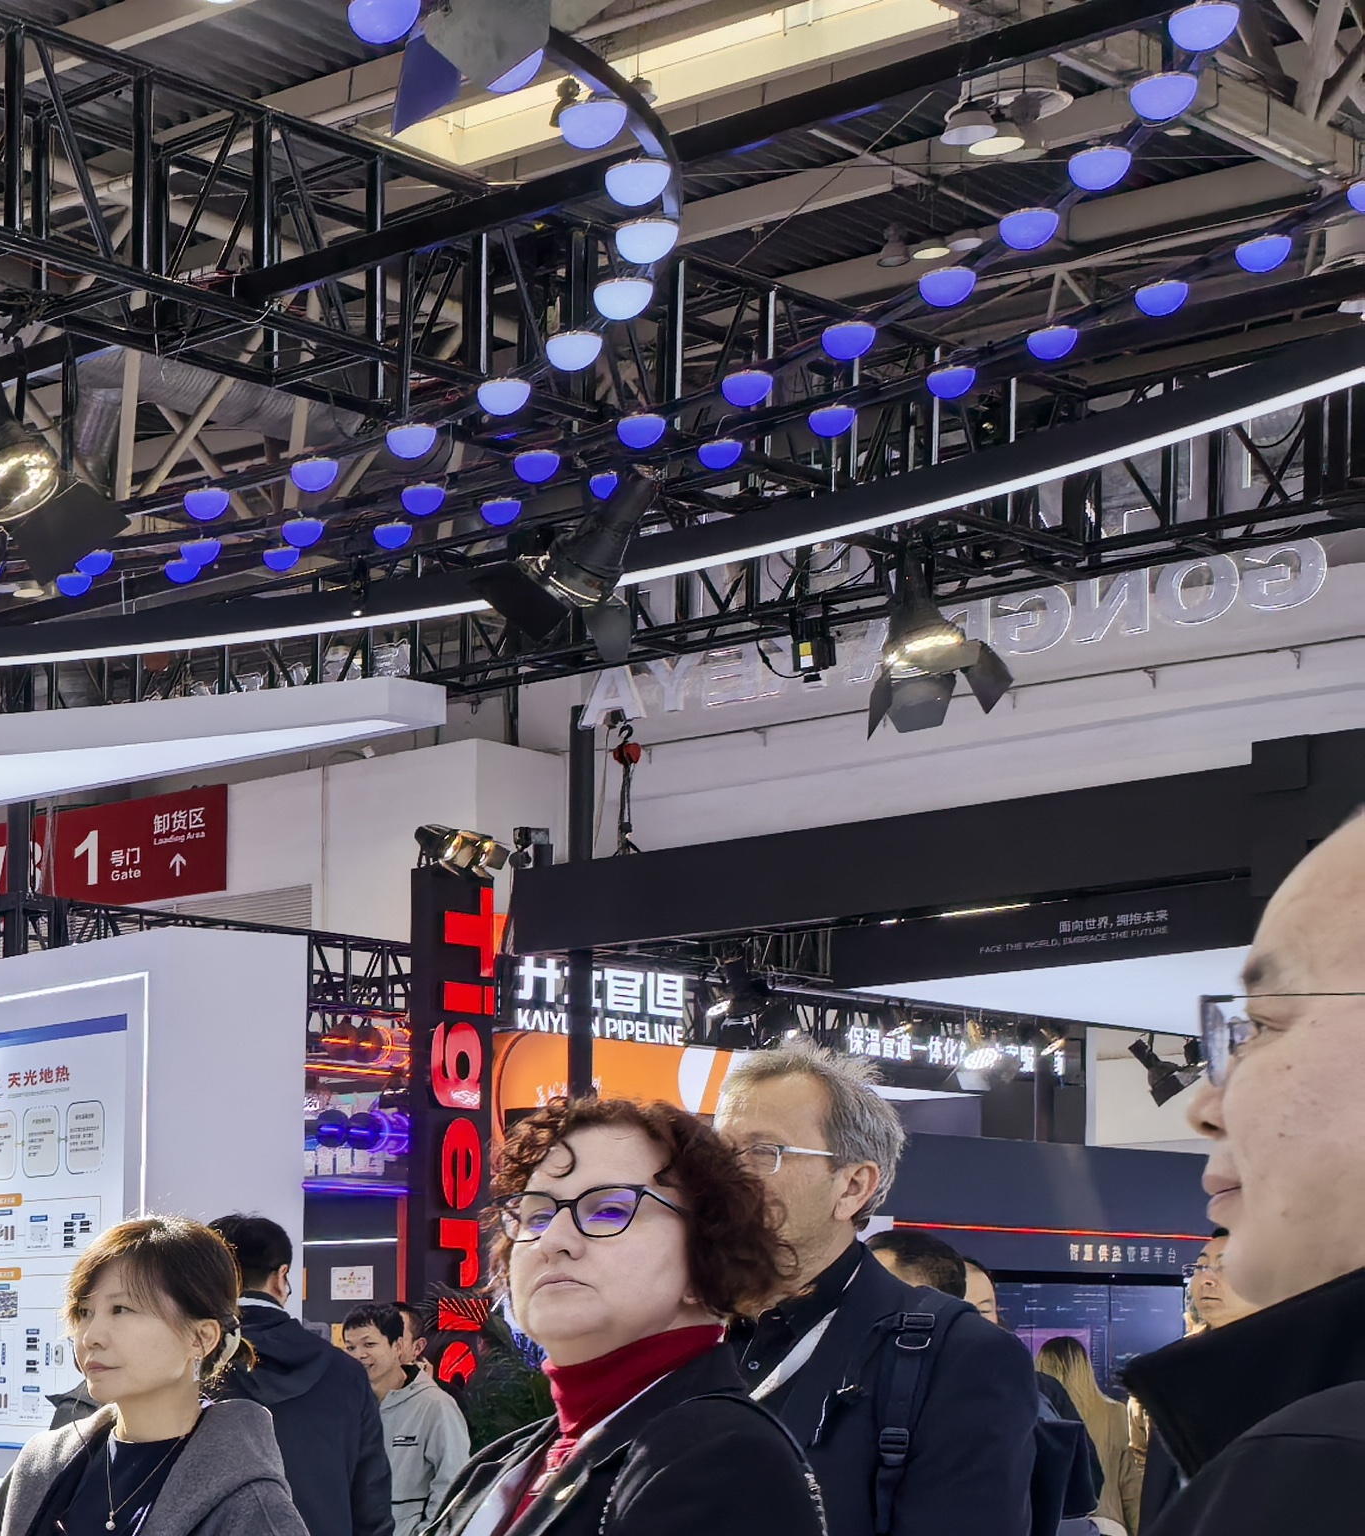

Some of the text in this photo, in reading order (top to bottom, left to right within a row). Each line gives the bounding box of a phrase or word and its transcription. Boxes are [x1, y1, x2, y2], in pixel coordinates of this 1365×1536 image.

[153, 807, 205, 835] 卸货区
[74, 829, 100, 887] 1
[109, 846, 141, 869] 号门
[110, 867, 142, 882] Gate
[979, 945, 1002, 954] FACE
[604, 1017, 685, 1046] PIPELINE
[7, 1065, 71, 1089] 天光地热
[1069, 1242, 1178, 1265] 智慧供热管理平台
